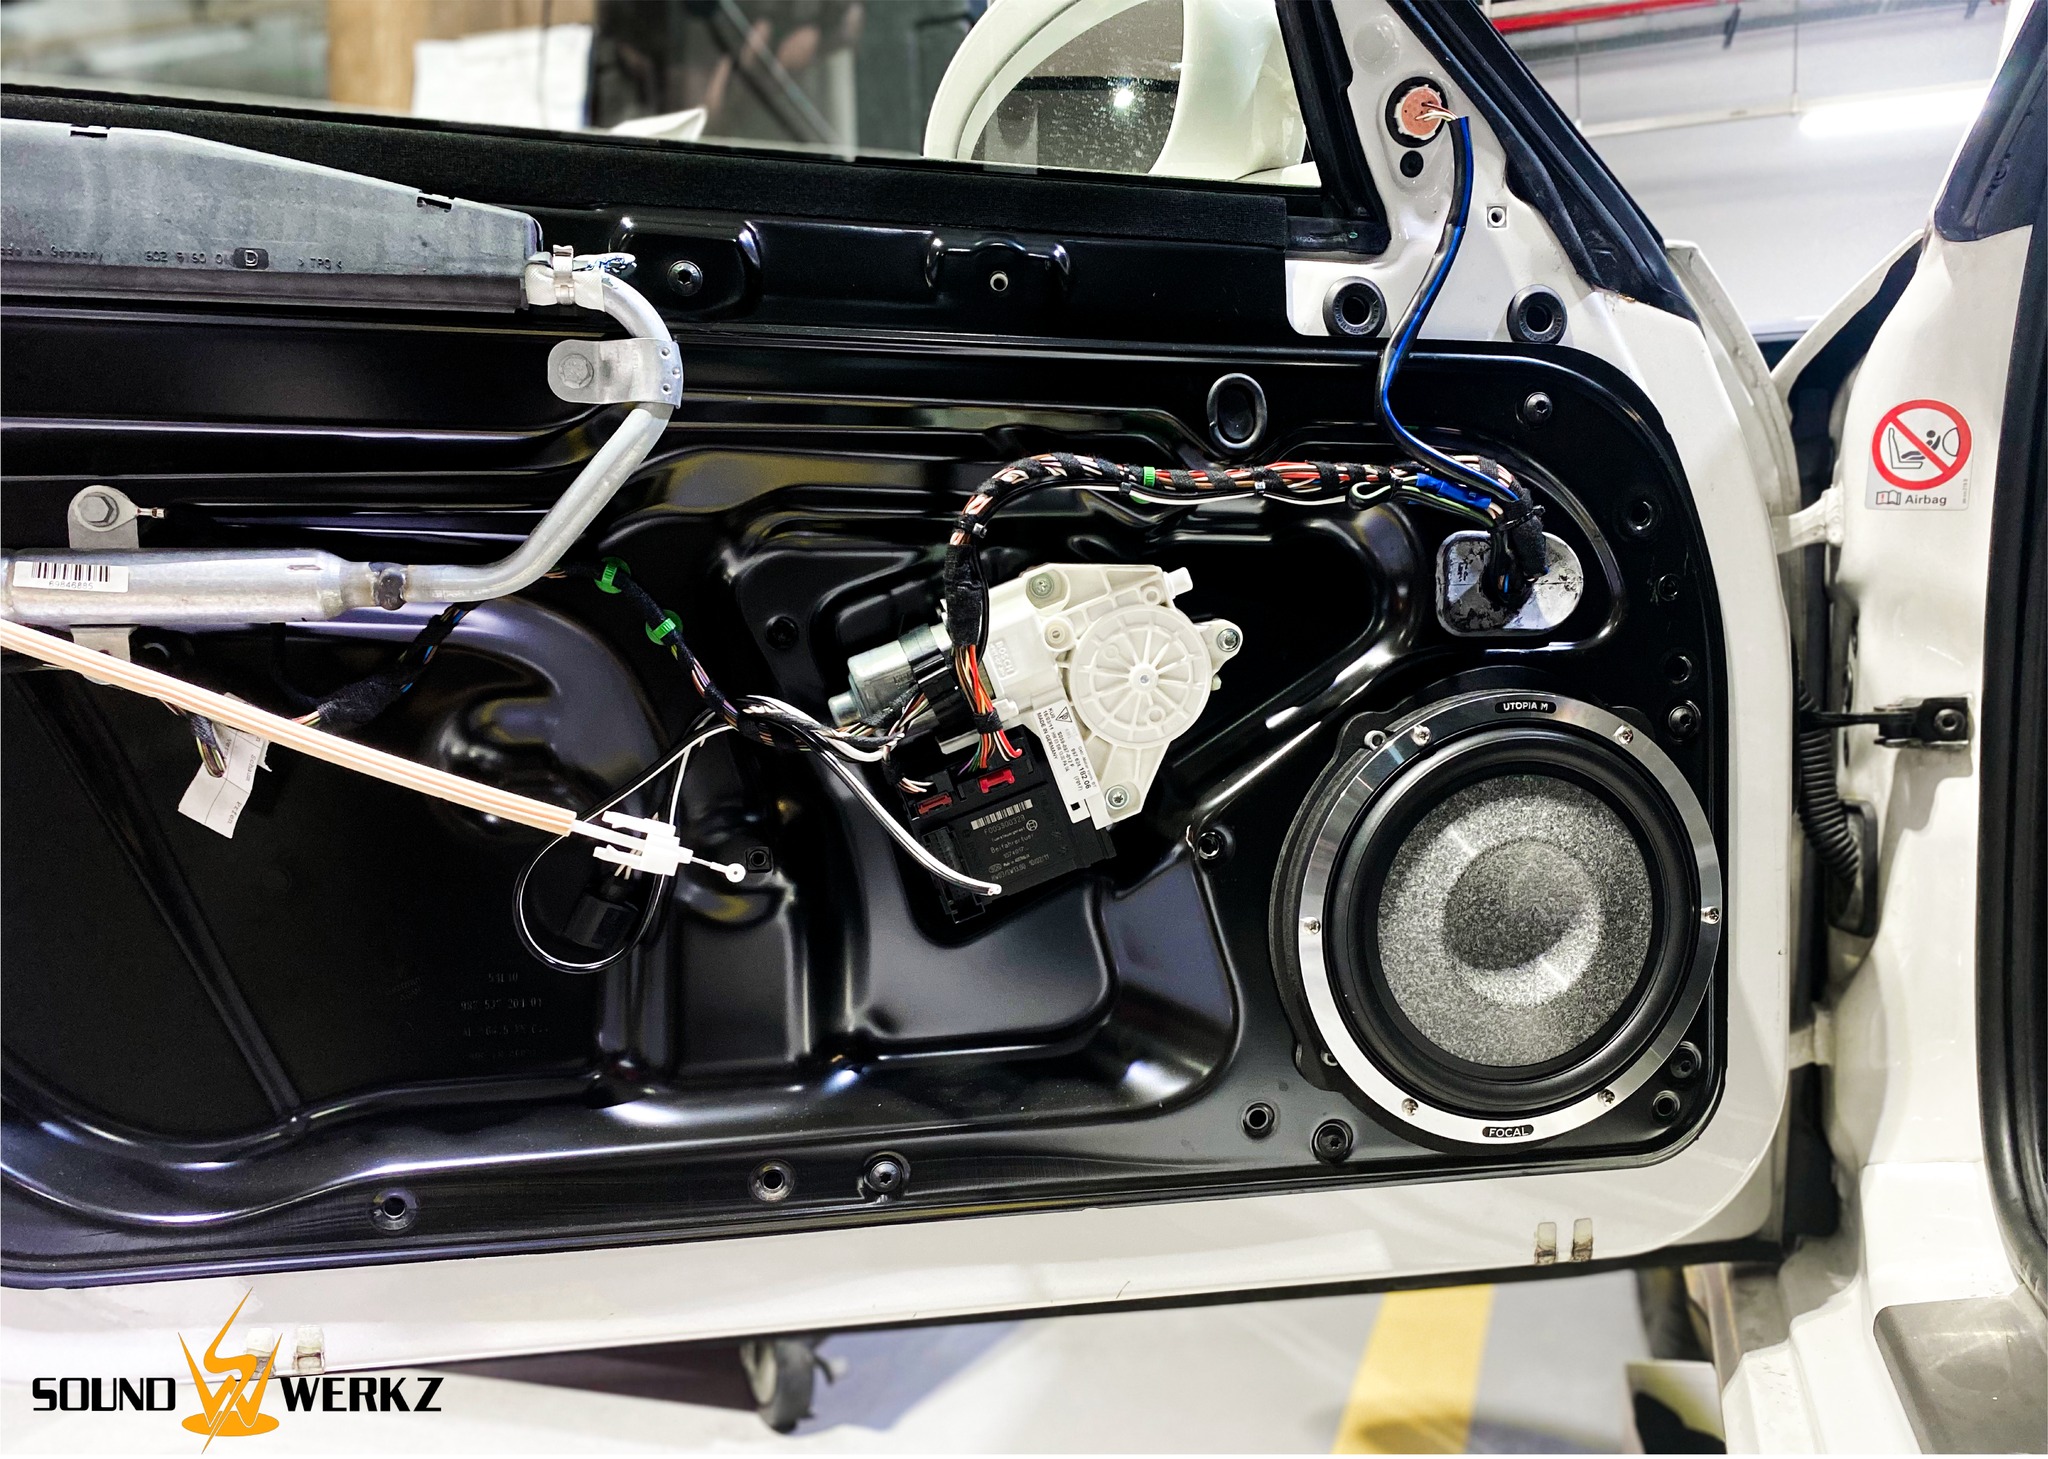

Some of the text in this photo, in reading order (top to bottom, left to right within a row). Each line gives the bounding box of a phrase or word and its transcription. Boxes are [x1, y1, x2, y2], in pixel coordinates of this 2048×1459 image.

[244, 249, 259, 267] D
[1905, 495, 1947, 506] Airbag
[996, 641, 1015, 673] BOSCH
[1503, 702, 1548, 711] UTOPIA M
[1037, 712, 1046, 728] MADE
[1045, 734, 1058, 759] GERMANY
[245, 754, 257, 782] Schaum
[1488, 1126, 1529, 1137] FOCAL
